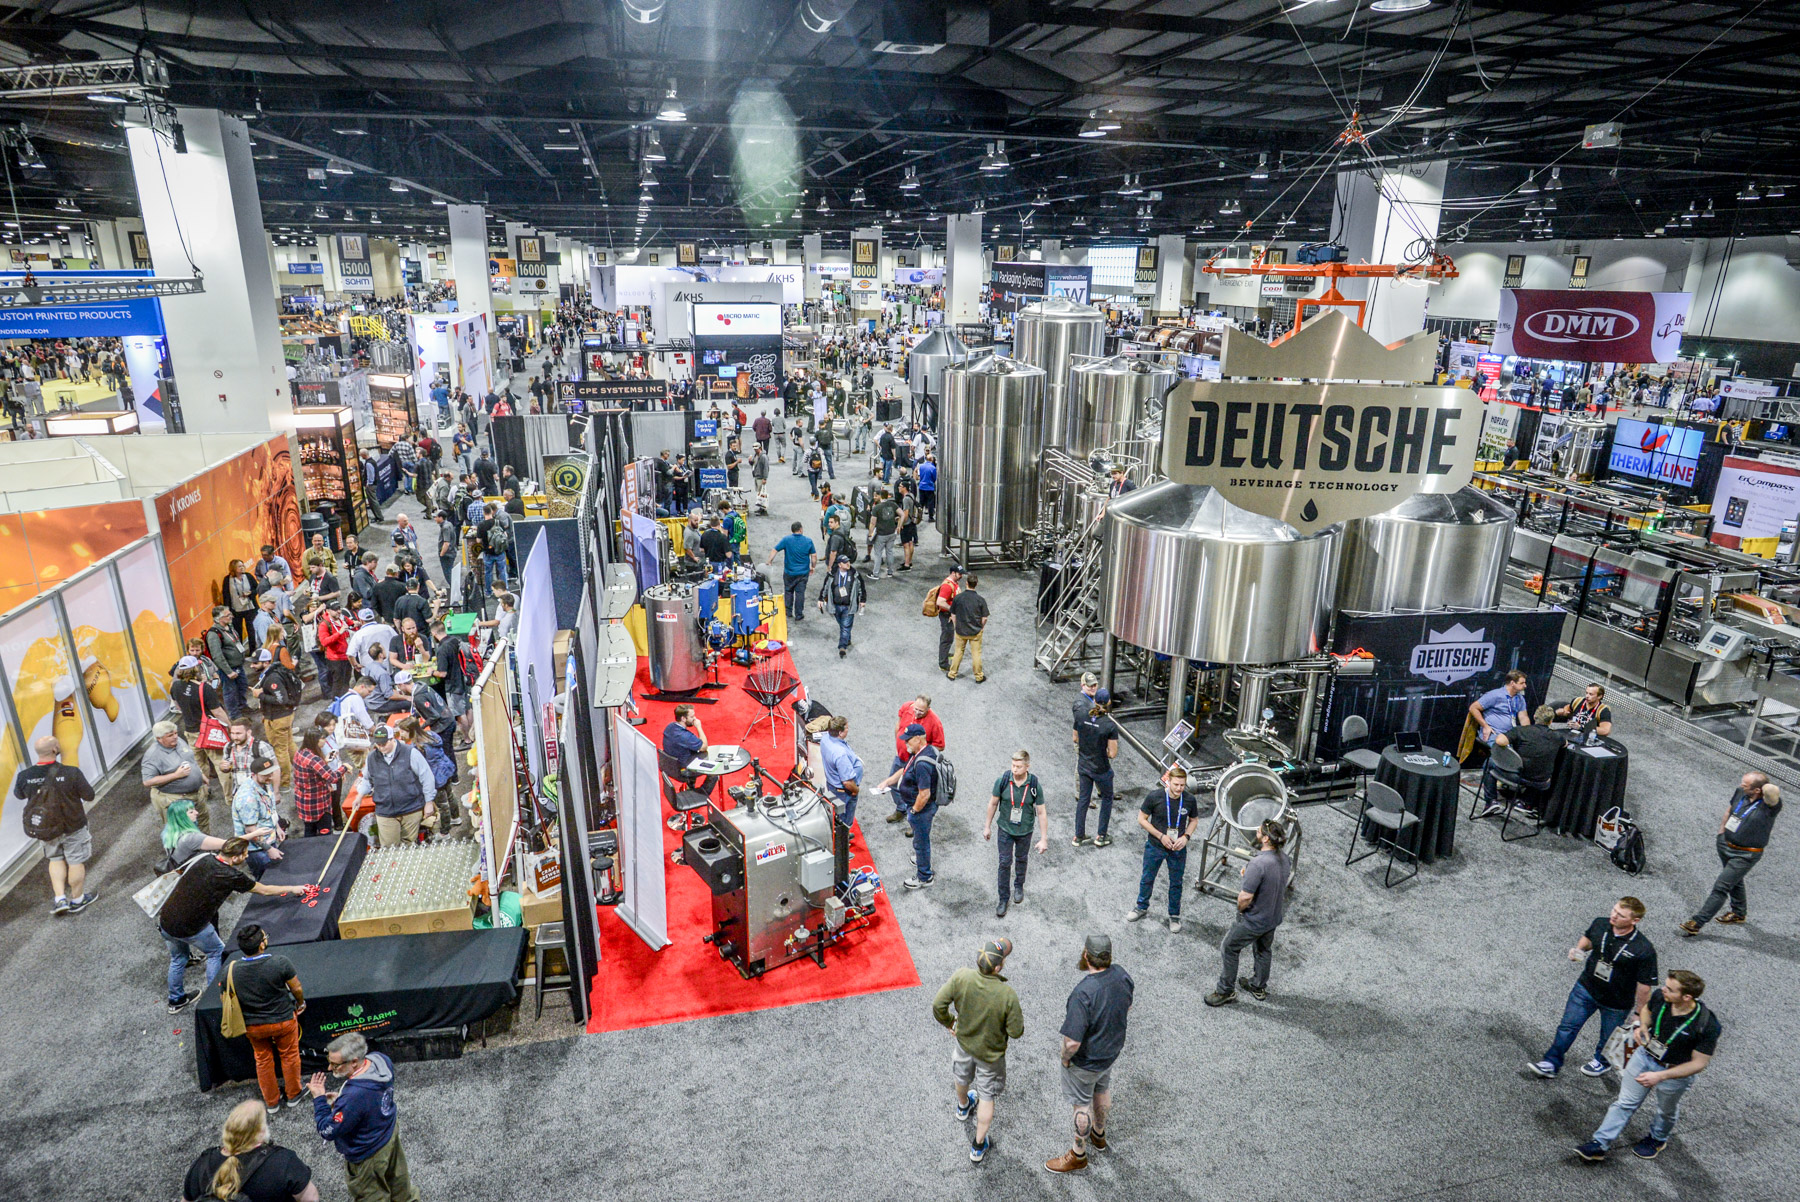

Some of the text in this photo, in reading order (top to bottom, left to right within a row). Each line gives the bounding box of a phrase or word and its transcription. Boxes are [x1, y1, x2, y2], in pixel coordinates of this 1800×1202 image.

[341, 262, 370, 275] 15000
[519, 263, 546, 276] 16000
[853, 264, 877, 277] 18000
[775, 274, 795, 283] KHS
[999, 271, 1021, 286] Packaging
[1022, 273, 1044, 289] Systems
[1135, 270, 1157, 282] 20000
[1503, 277, 1522, 287] 23000
[1569, 277, 1587, 288] 24000
[1244, 280, 1254, 288] EXIT
[683, 293, 704, 302] KHS
[36, 312, 77, 320] PRINTED
[79, 310, 132, 319] PRODUCTS
[1543, 313, 1617, 336] DMM
[600, 386, 643, 394] SYSTEMS
[645, 385, 664, 393] INC
[1185, 401, 1462, 476] DEUTSCHE
[1611, 452, 1694, 482] THERMALINE
[563, 473, 573, 486] P
[1230, 478, 1398, 492] BEVERAGE TECHNOLOGY
[177, 489, 201, 512] KRONES
[1416, 648, 1489, 668] DEUTSCHE
[1324, 675, 1336, 732] heBeverage.com
[757, 845, 785, 860] BOILER
[541, 866, 558, 875] CRAFT
[320, 1010, 398, 1032] HOP HEAD FARMS
